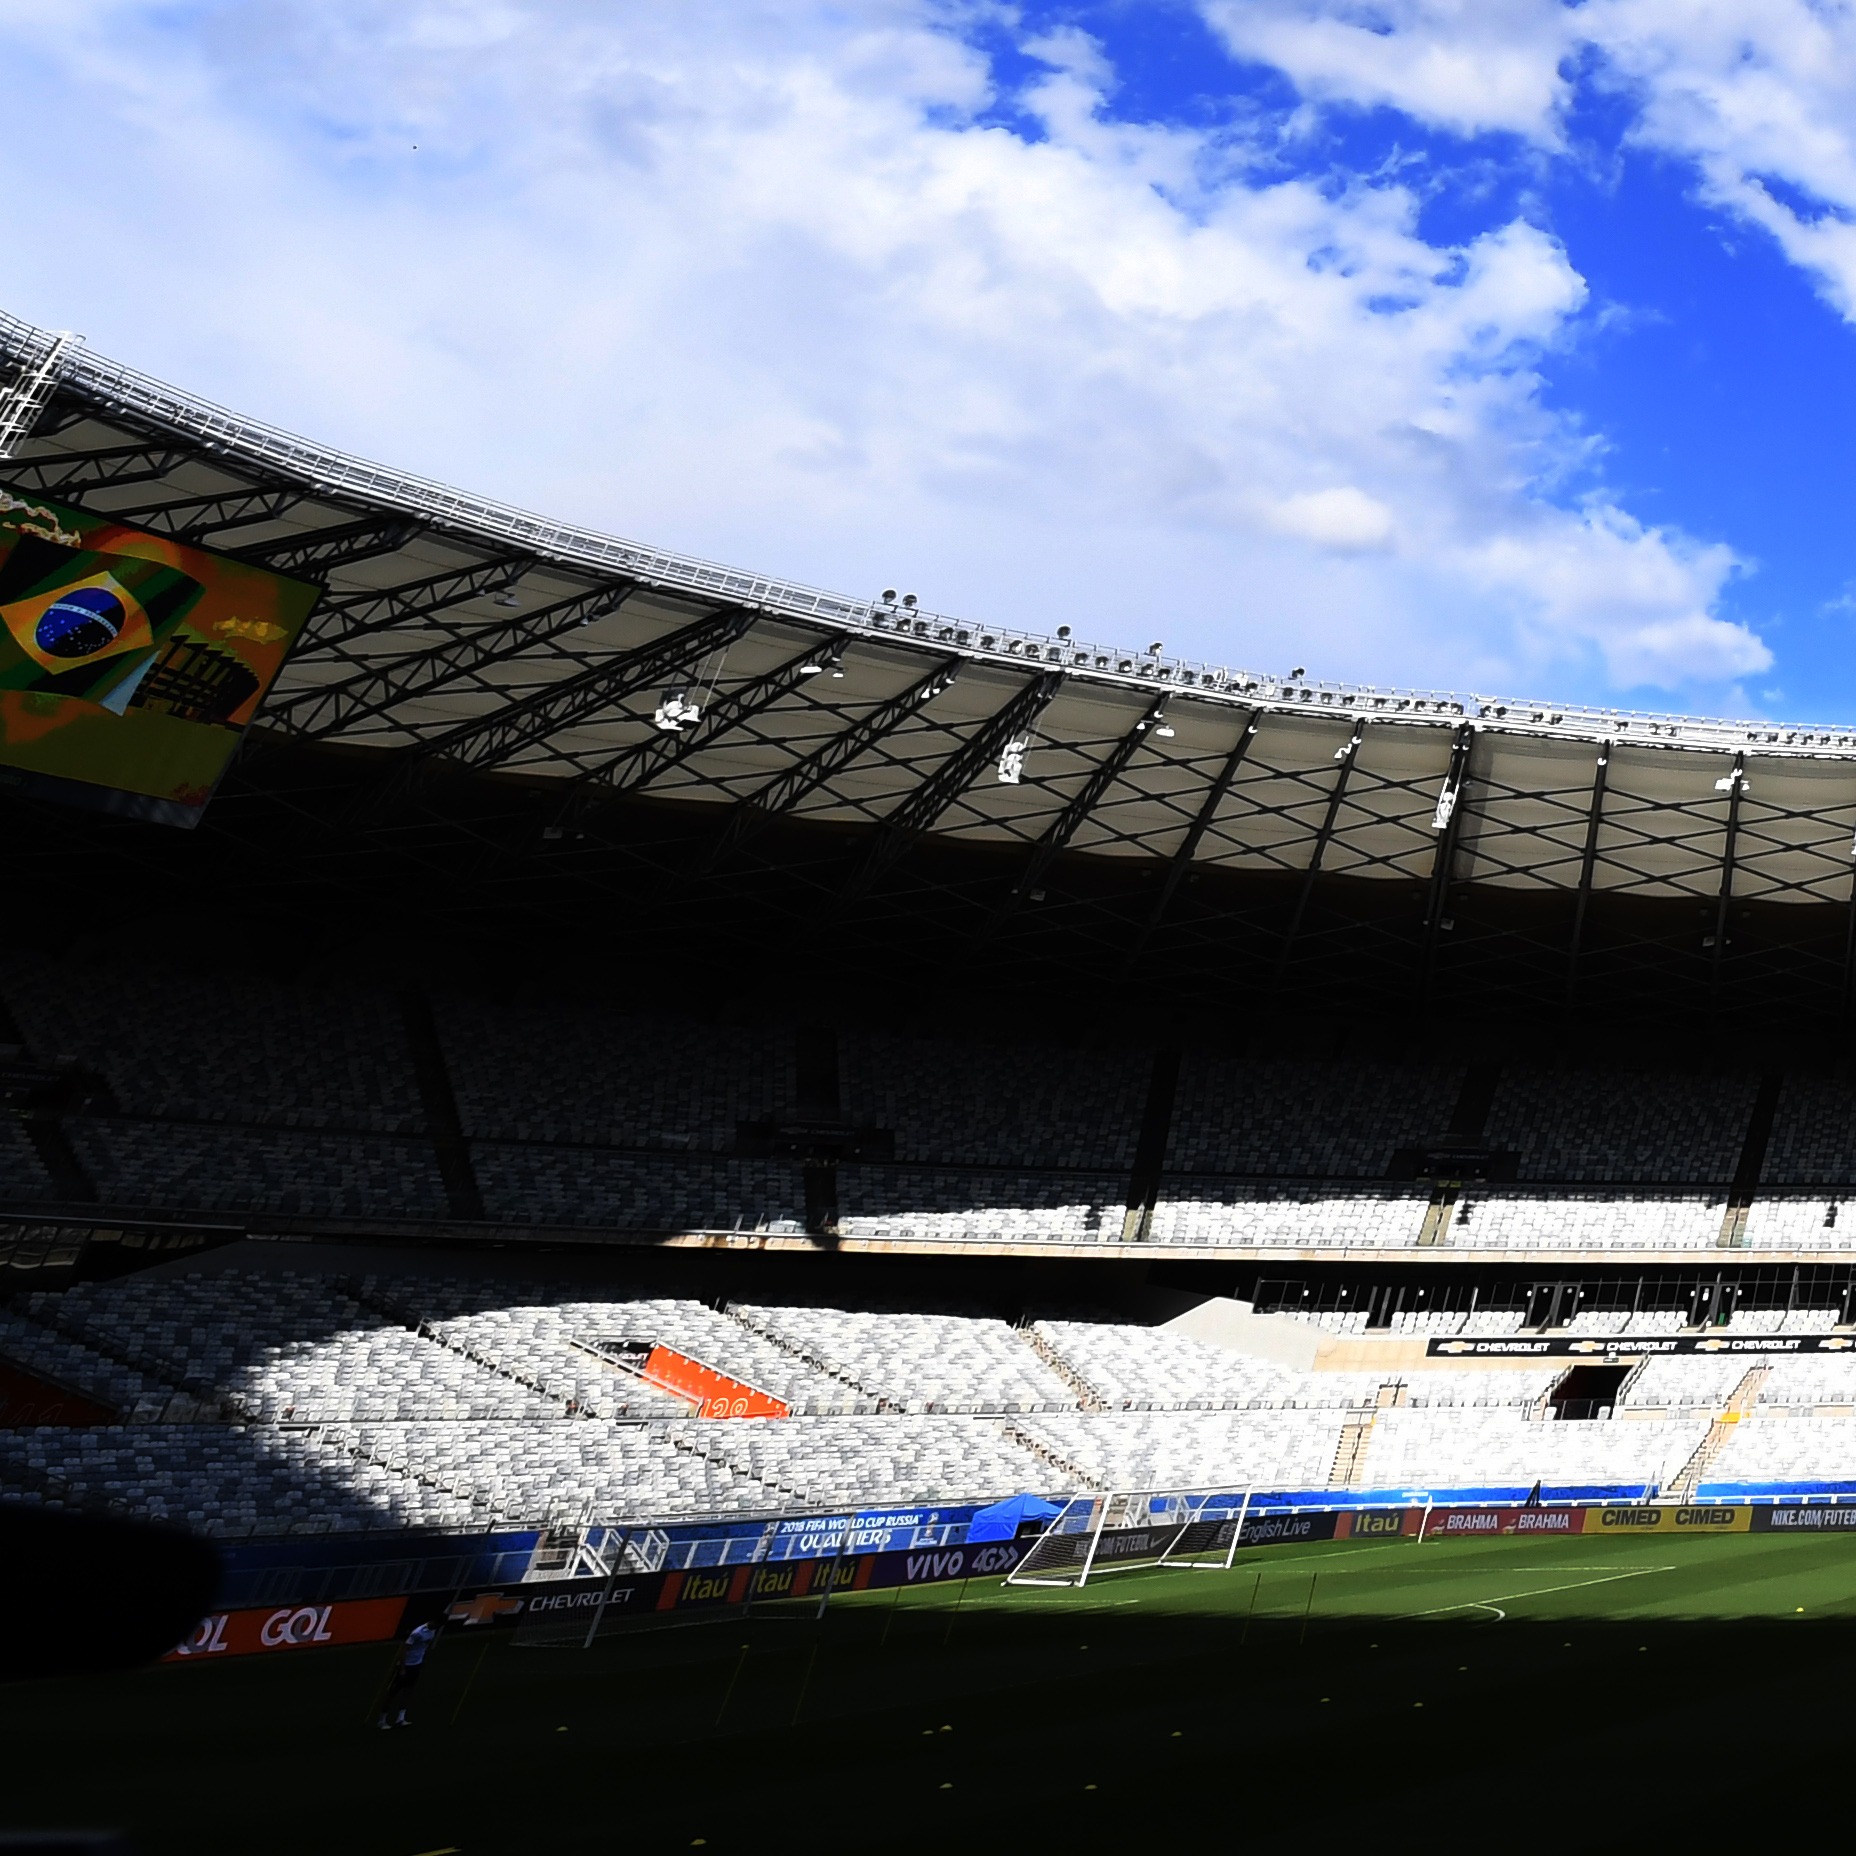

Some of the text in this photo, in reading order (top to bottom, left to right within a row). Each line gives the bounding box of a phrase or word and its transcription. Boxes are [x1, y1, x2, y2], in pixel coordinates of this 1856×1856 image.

[1476, 1342, 1549, 1352] CHEVROLET
[1606, 1341, 1677, 1351] CHEVROLET
[1731, 1339, 1801, 1350] CHEVROLET
[780, 1514, 920, 1533] 2018 FIFA WOLD CUP RUSSIA
[1355, 1513, 1400, 1533] Itaú
[1446, 1514, 1498, 1530] BRAHMA
[1518, 1513, 1570, 1529] BRAHMA
[1601, 1509, 1662, 1526] CIMED
[1674, 1508, 1736, 1526] CIMED
[1239, 1519, 1284, 1543] English
[1285, 1518, 1311, 1535] Live
[800, 1529, 892, 1552] QUALIERS
[906, 1550, 964, 1581] VIVO
[682, 1572, 729, 1601] Itaú
[260, 1605, 334, 1645] GOL
[173, 1616, 229, 1655] OL
